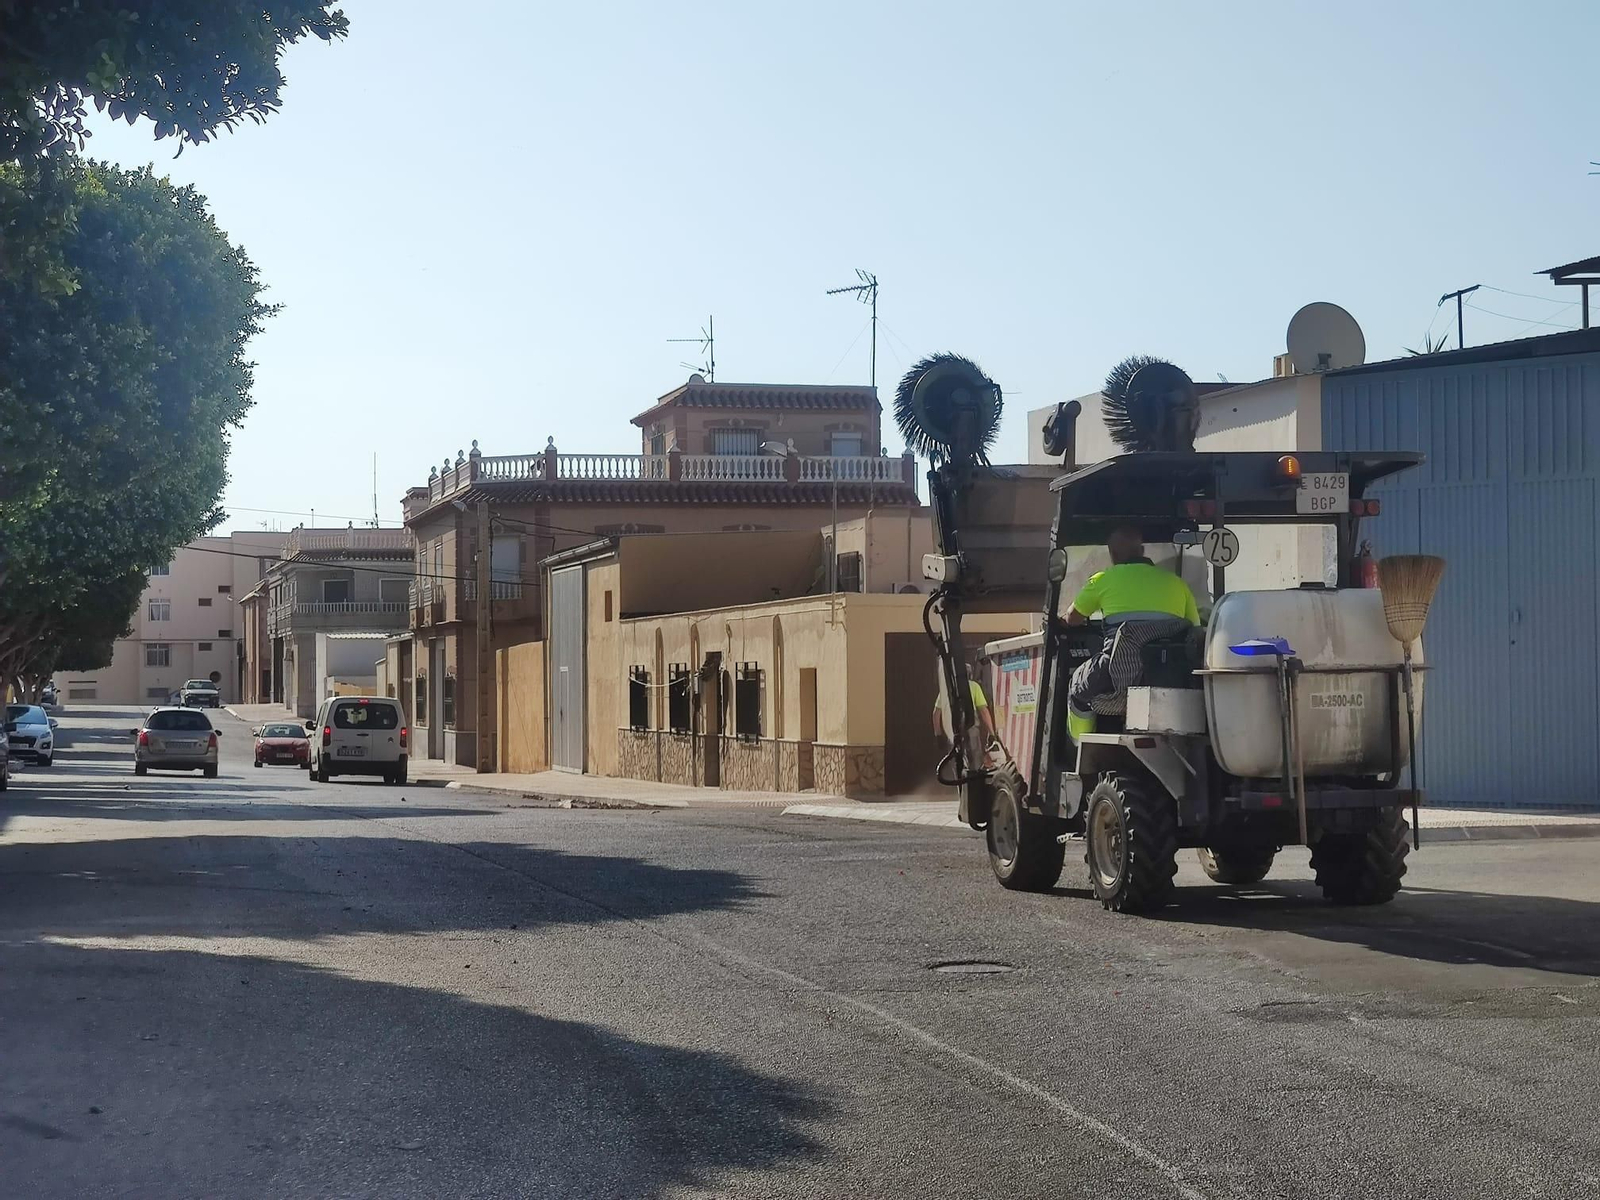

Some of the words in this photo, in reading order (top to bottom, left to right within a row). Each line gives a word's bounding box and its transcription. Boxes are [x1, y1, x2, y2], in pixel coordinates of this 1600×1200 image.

[1313, 475, 1346, 490] 8429
[1311, 496, 1336, 511] BGP
[1210, 531, 1232, 562] 25
